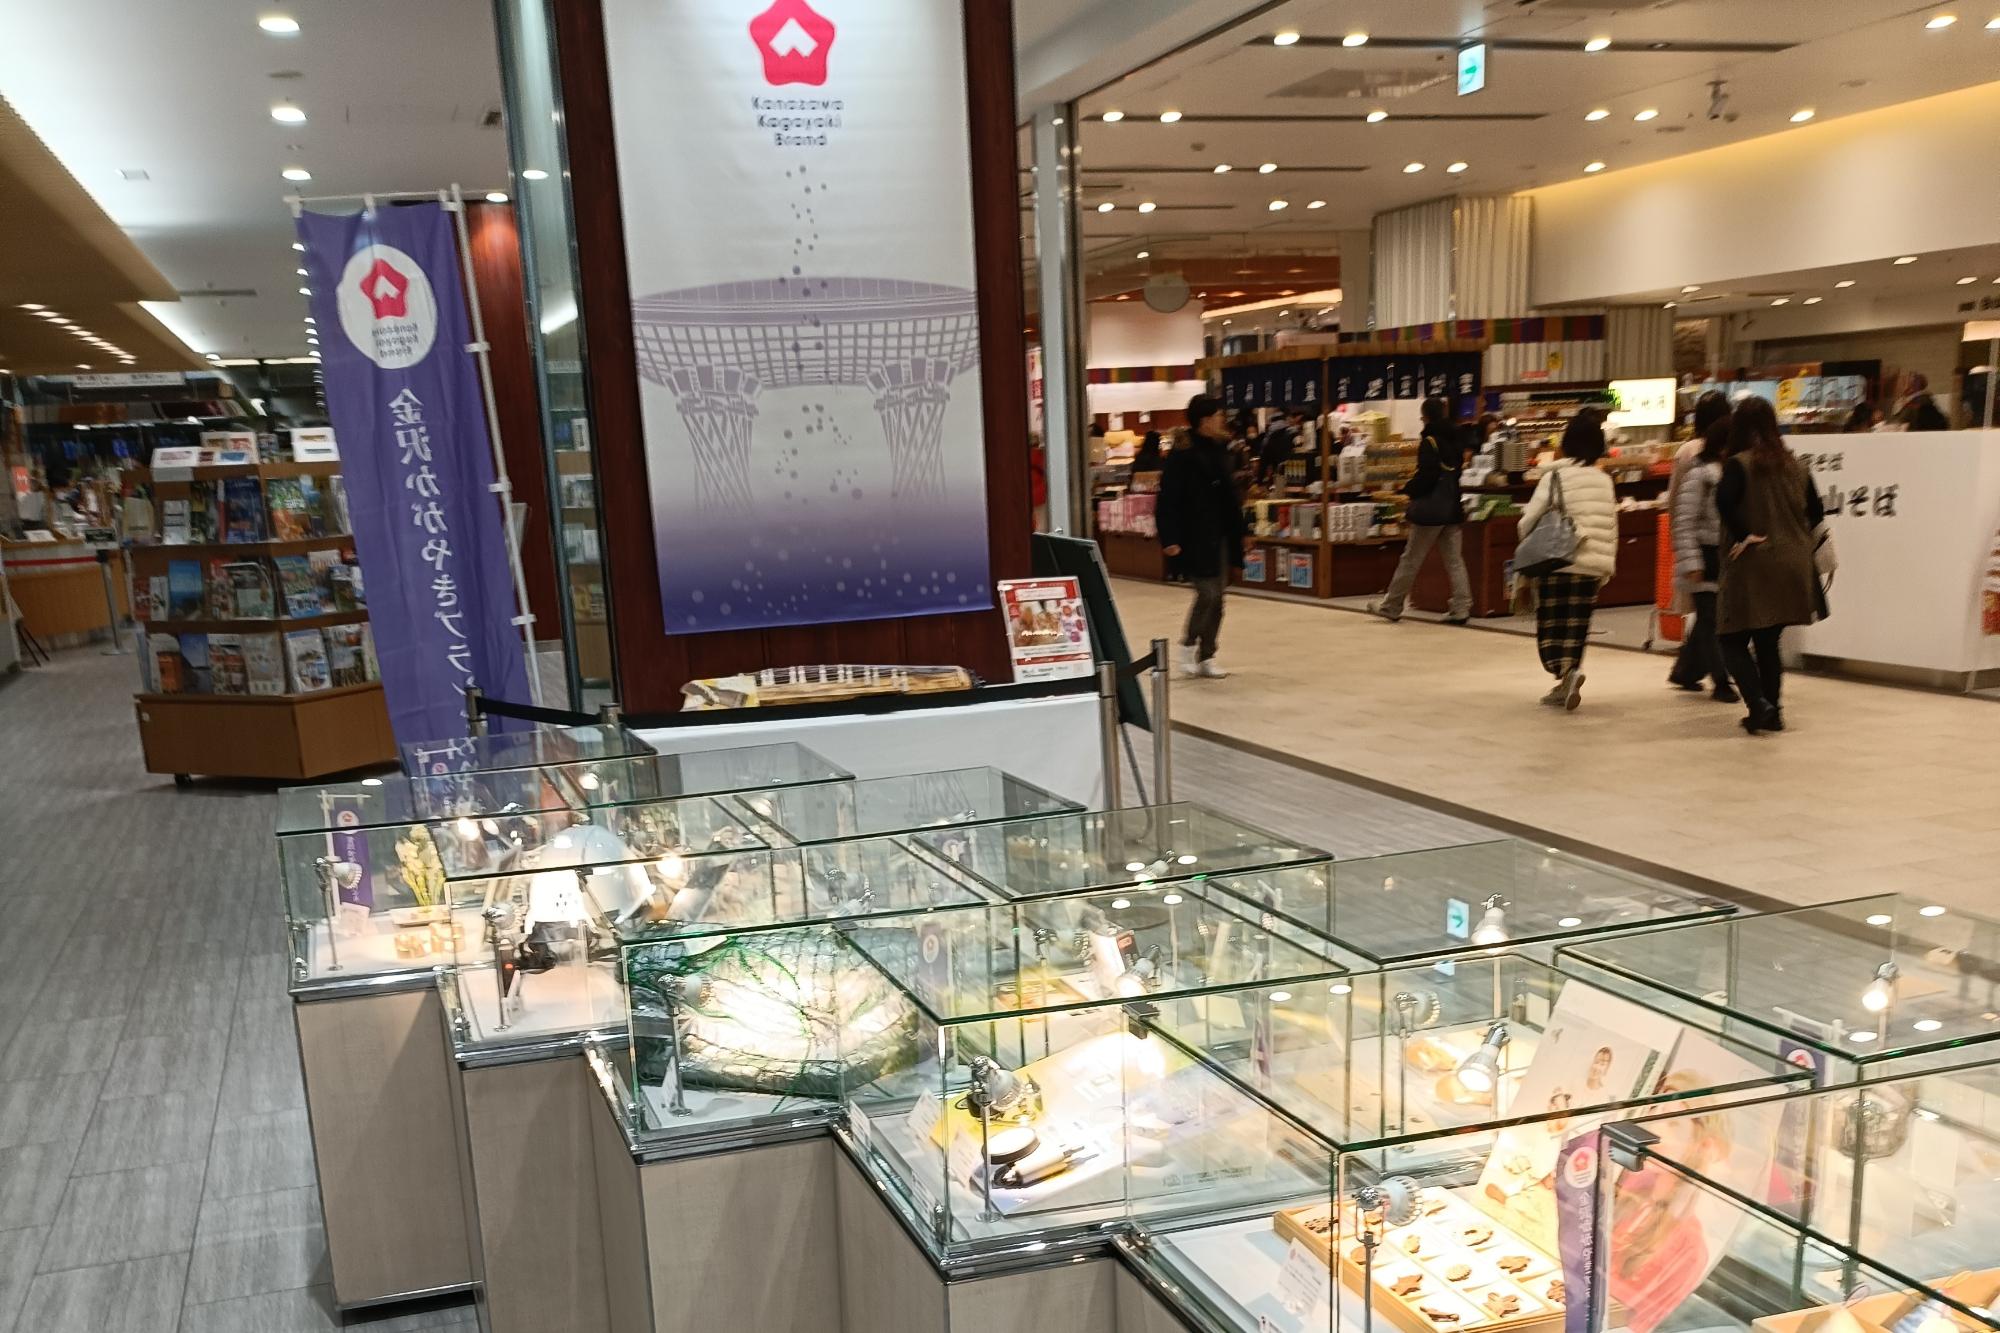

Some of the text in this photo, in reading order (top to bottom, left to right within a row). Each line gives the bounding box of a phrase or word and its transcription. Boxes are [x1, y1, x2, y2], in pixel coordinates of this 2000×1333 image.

[752, 97, 844, 110] Kanazawa
[758, 115, 841, 131] Kagayaki
[775, 132, 827, 146] Brand
